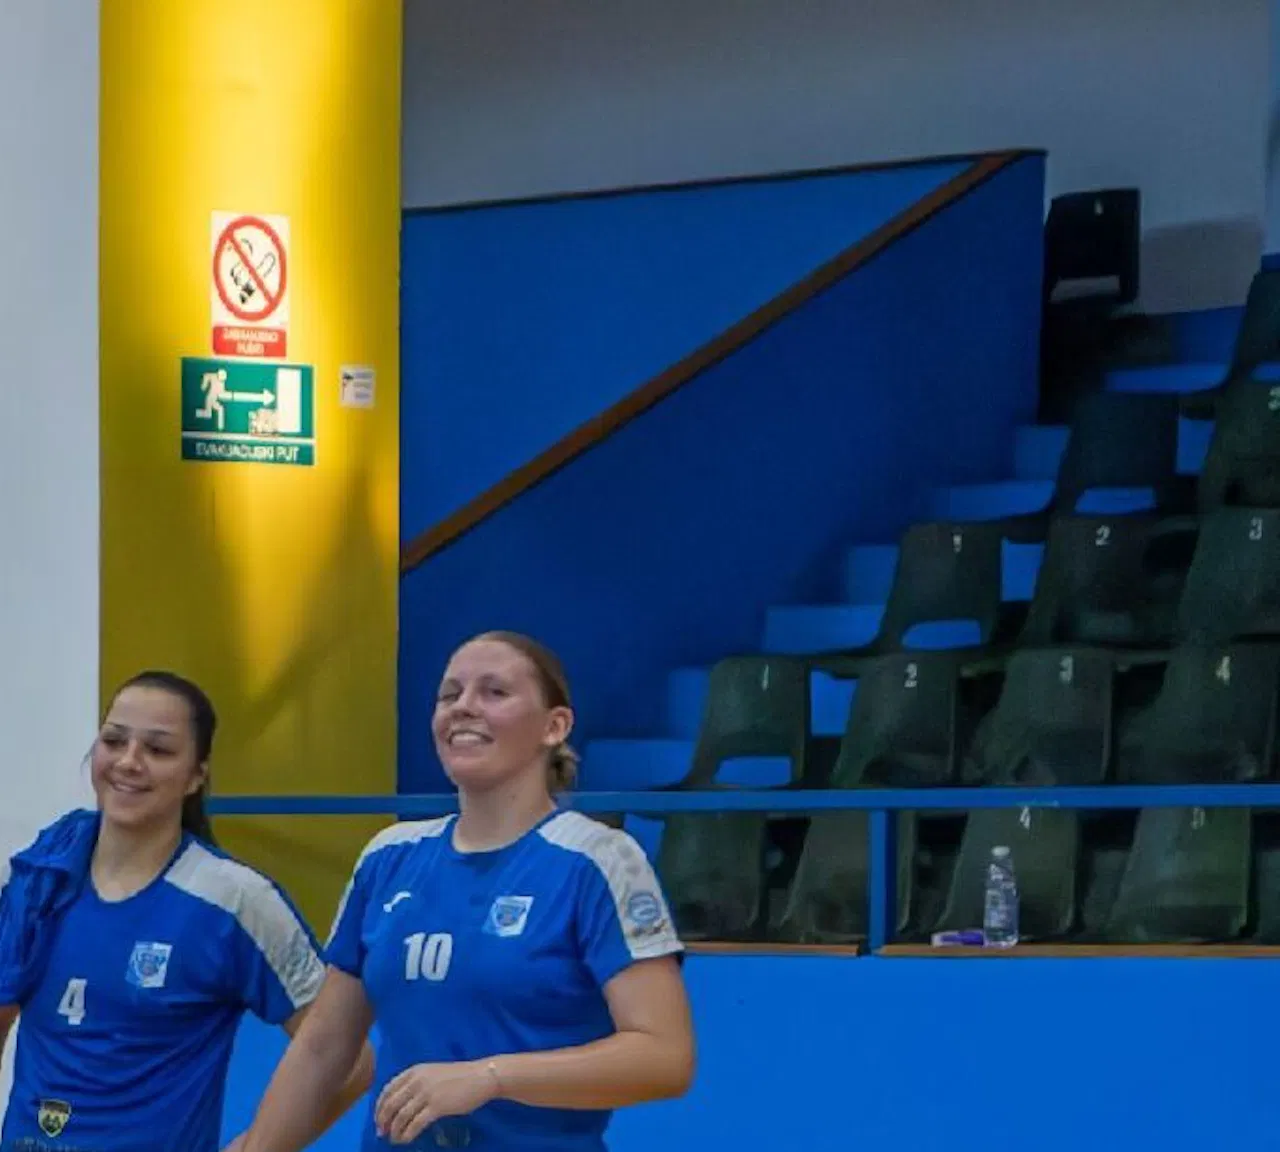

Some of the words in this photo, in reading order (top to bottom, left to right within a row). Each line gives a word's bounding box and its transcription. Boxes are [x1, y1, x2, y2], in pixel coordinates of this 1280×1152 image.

[1096, 525, 1112, 546] 2
[1249, 516, 1264, 542] 3
[904, 663, 918, 688] 2
[1216, 656, 1231, 686] 4
[403, 931, 453, 982] 10
[57, 977, 89, 1026] 4
